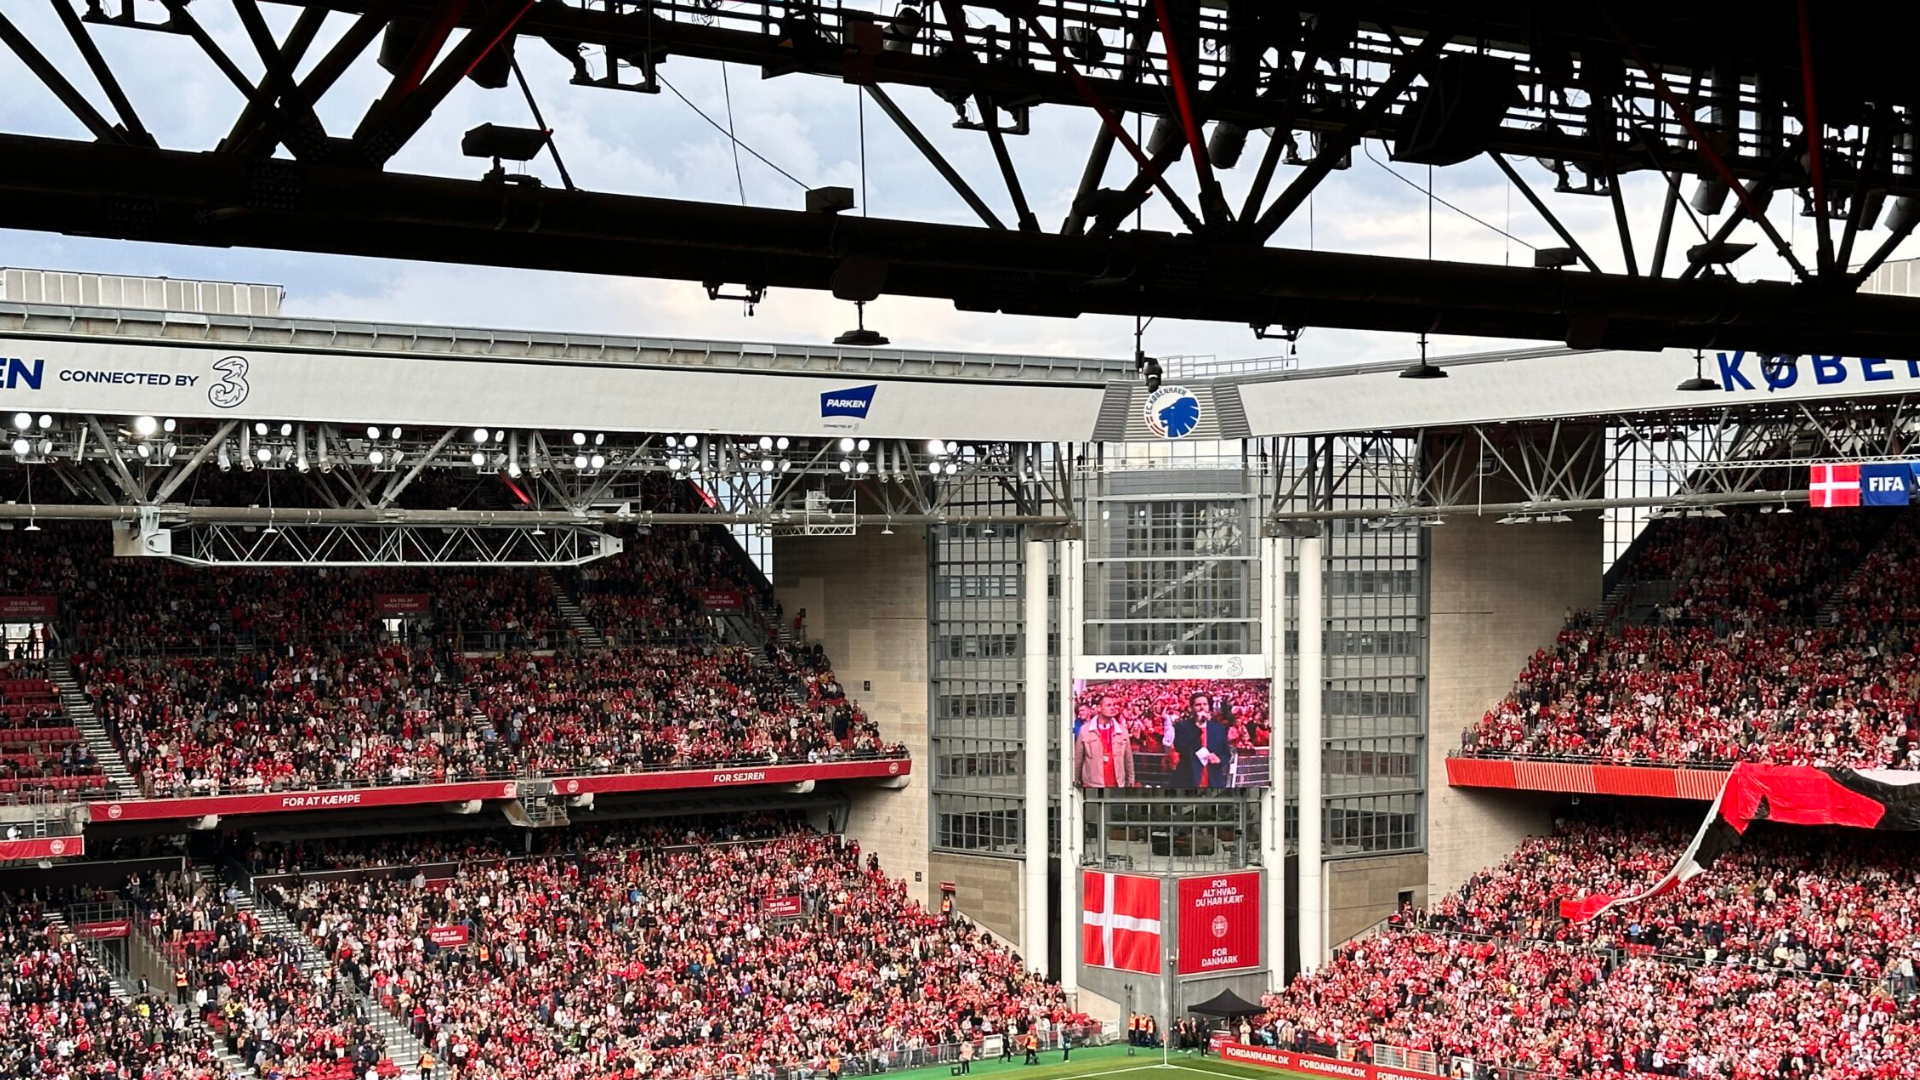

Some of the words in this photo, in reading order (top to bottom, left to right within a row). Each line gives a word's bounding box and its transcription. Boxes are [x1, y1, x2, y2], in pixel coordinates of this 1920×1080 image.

[1716, 350, 1920, 392] KØBE
[59, 370, 170, 386] CONNECTED
[175, 375, 199, 386] BY
[208, 356, 249, 408] 3
[826, 398, 866, 408] PARKEN
[1869, 476, 1905, 492] FIFA
[1095, 662, 1167, 673] PARKEN
[1226, 656, 1243, 677] 3
[713, 774, 732, 782] FOR
[732, 772, 765, 781] SEJREN
[282, 797, 304, 807] FOR
[306, 796, 320, 806] AT
[321, 794, 361, 805] KÆMPE
[1212, 879, 1227, 888] FOR
[1202, 889, 1216, 898] ALT
[1216, 887, 1237, 896] HVAD
[1195, 899, 1206, 907] DU
[1207, 897, 1223, 906] HAR
[1223, 894, 1244, 904] KÆRT
[1212, 948, 1227, 957] FOR
[1201, 955, 1238, 967] DANMARK
[1226, 1047, 1289, 1065] FORDANMARK.DK
[1299, 1059, 1366, 1078] FORDANMARK.DK
